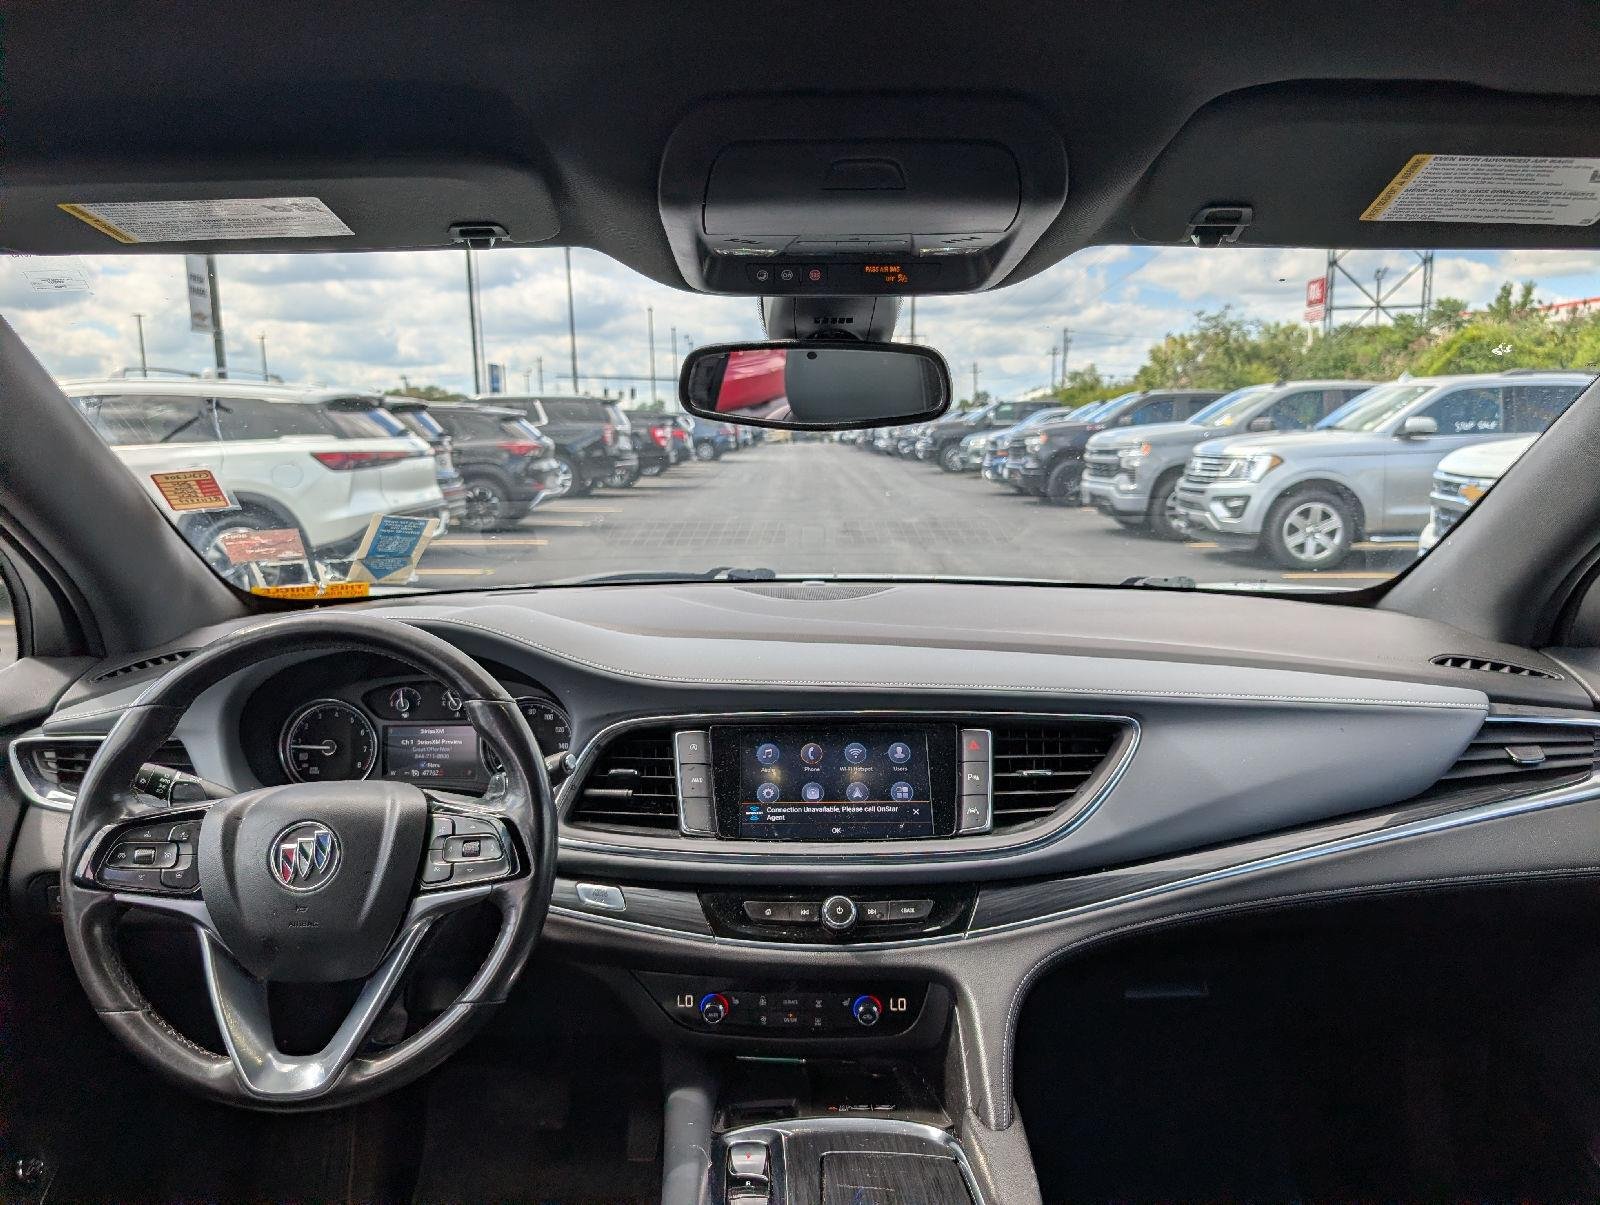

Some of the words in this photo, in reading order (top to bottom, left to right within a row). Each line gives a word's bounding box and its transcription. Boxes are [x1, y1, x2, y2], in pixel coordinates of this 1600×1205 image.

[766, 814, 786, 822] Agent
[677, 994, 694, 1008] LO
[889, 997, 907, 1011] LO
